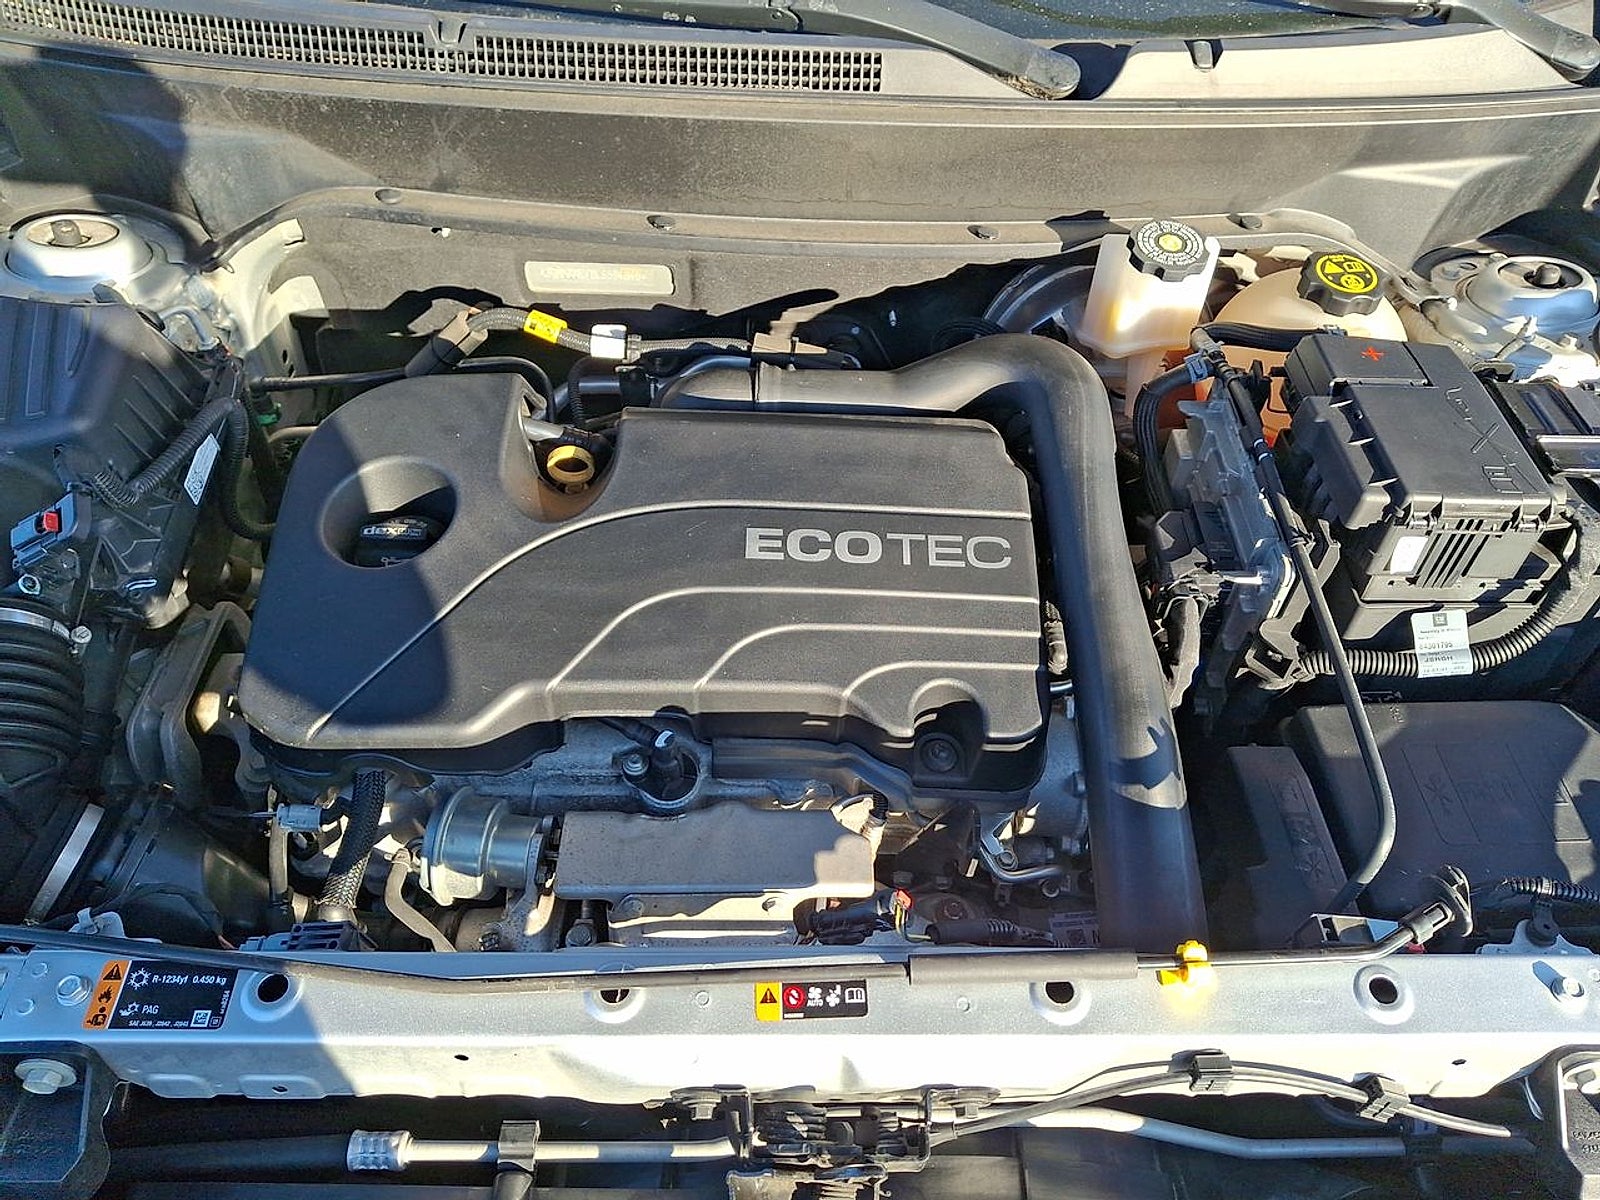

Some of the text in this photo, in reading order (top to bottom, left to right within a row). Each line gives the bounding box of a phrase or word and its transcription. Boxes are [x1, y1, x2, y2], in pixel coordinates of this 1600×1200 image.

[745, 527, 1012, 569] ECOTEC
[152, 974, 227, 985] R-1234yf 0.450 kg
[806, 998, 824, 1007] AUTO
[141, 1004, 160, 1014] PAG
